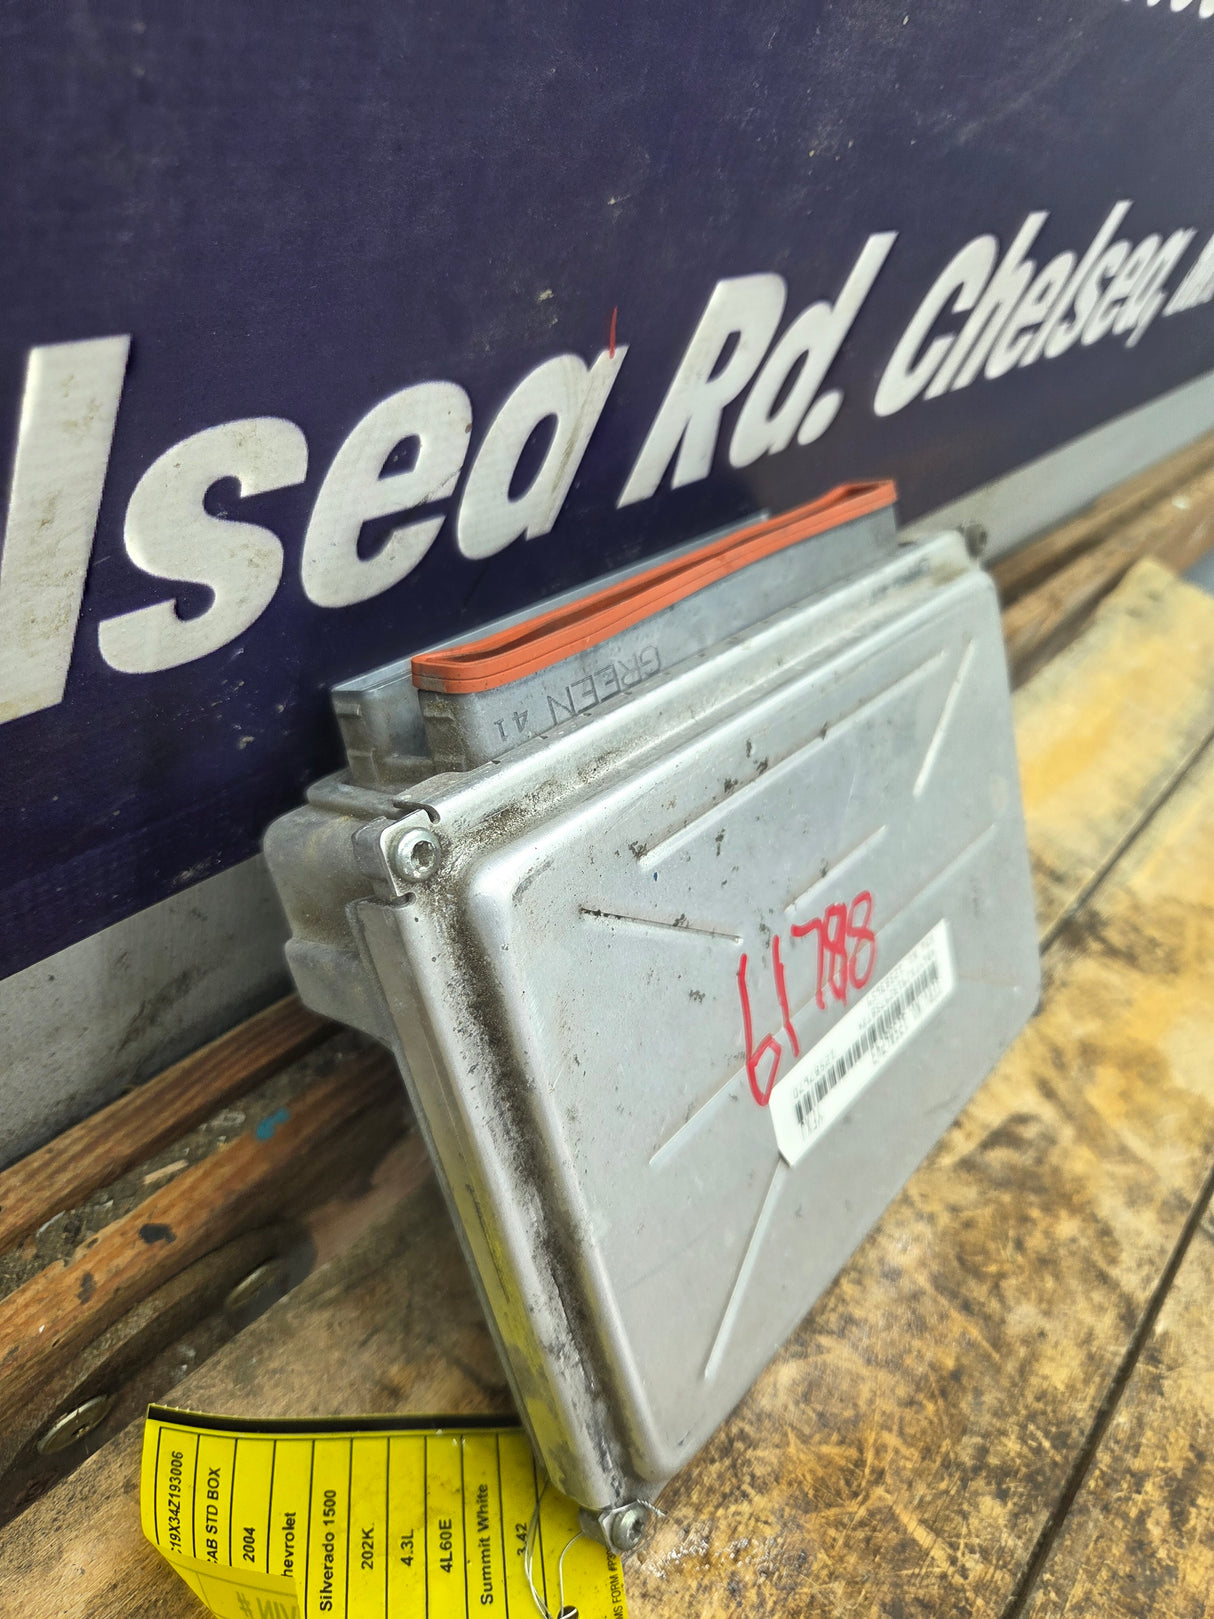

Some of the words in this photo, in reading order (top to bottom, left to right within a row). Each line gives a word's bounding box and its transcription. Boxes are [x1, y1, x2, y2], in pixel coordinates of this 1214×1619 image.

[617, 231, 898, 508] Rd.
[873, 200, 1198, 416] Chelsea,
[547, 645, 661, 726] GREEN
[494, 709, 528, 742] 41
[737, 890, 876, 1107] 61788
[206, 1467, 221, 1501] BOX
[206, 1504, 219, 1535] STD
[323, 1489, 337, 1526] 1500
[476, 1483, 489, 1533] White
[243, 1526, 256, 1563] 2004
[400, 1528, 414, 1567] 4.3L
[438, 1518, 453, 1573] 4L60E
[514, 1522, 528, 1557] 3.42
[319, 1531, 336, 1612] Silverado
[477, 1535, 494, 1605] Summit
[610, 1573, 622, 1605] FORM
